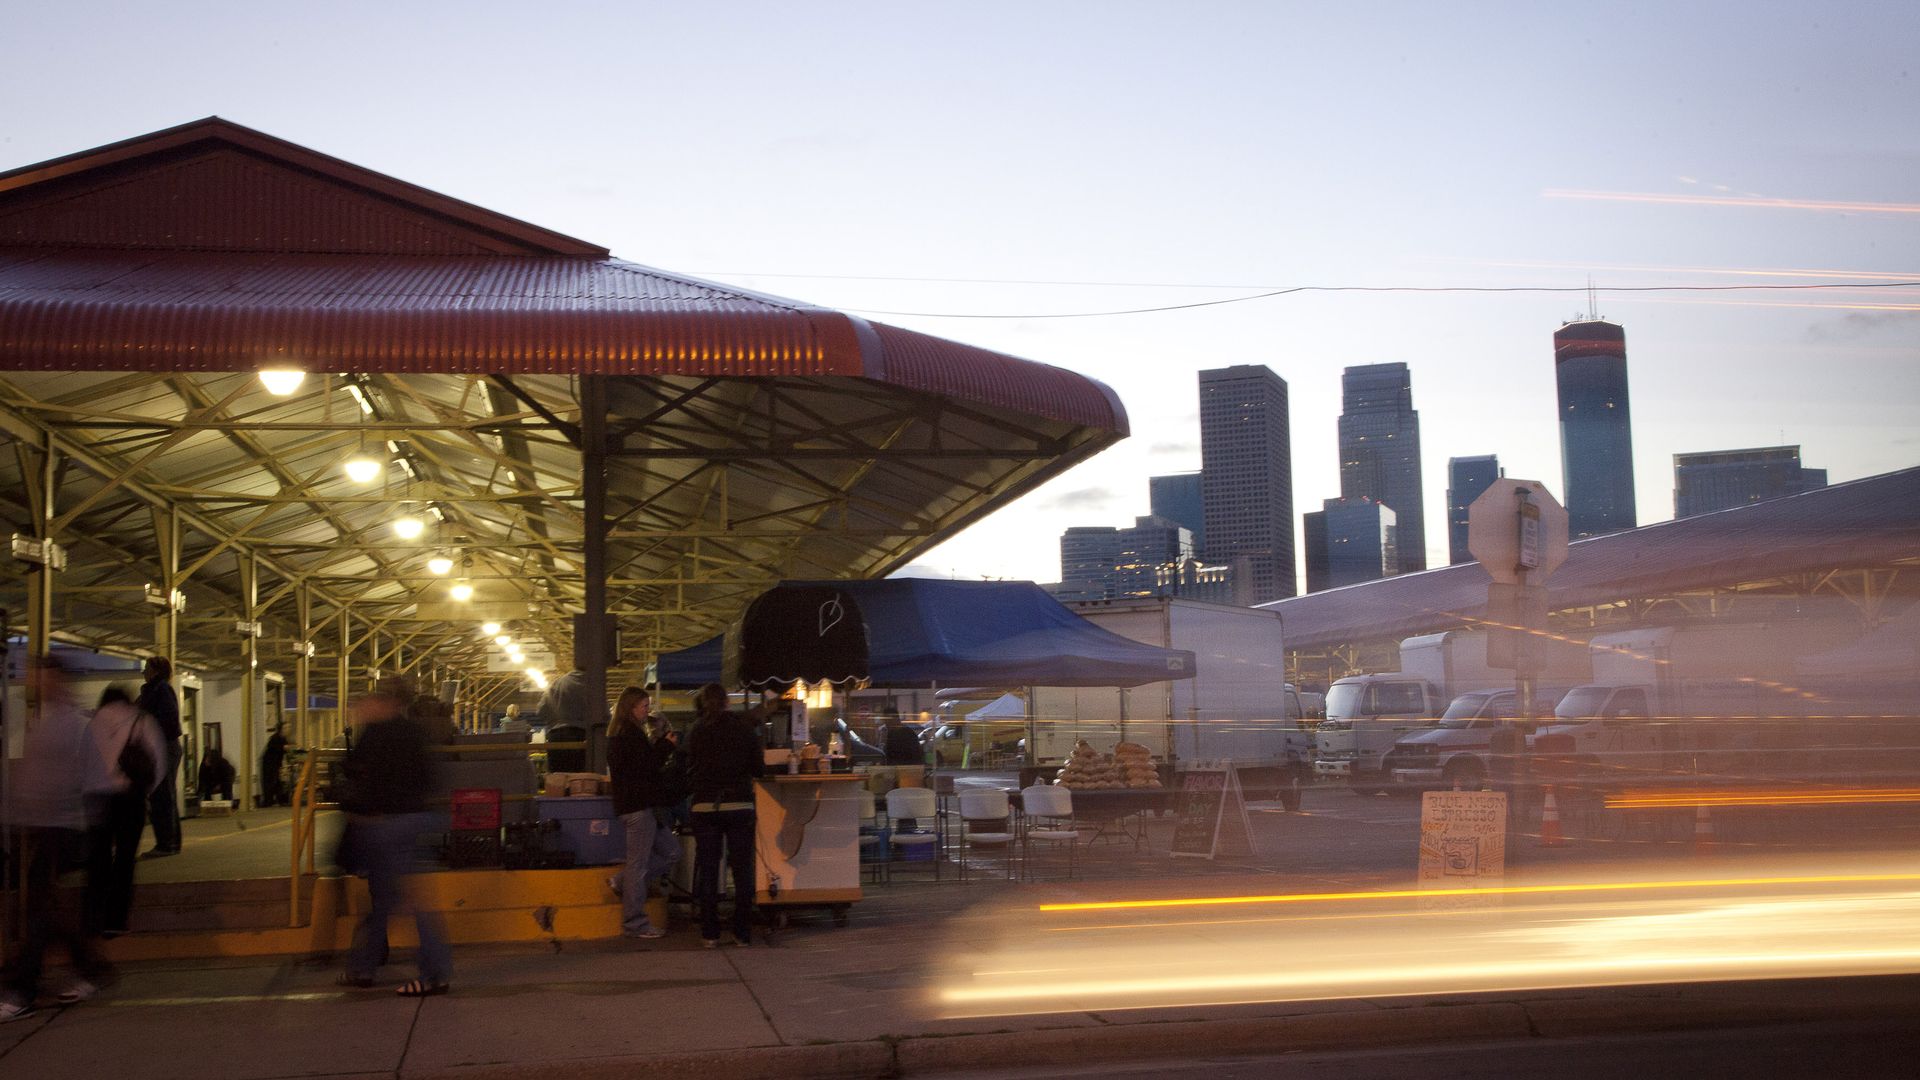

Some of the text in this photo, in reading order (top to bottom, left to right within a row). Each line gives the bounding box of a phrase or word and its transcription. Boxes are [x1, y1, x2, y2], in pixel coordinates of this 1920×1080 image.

[1429, 796, 1505, 808] BLUE NEON
[1188, 802, 1213, 816] DAY
[1431, 809, 1496, 822] ESPRESSO
